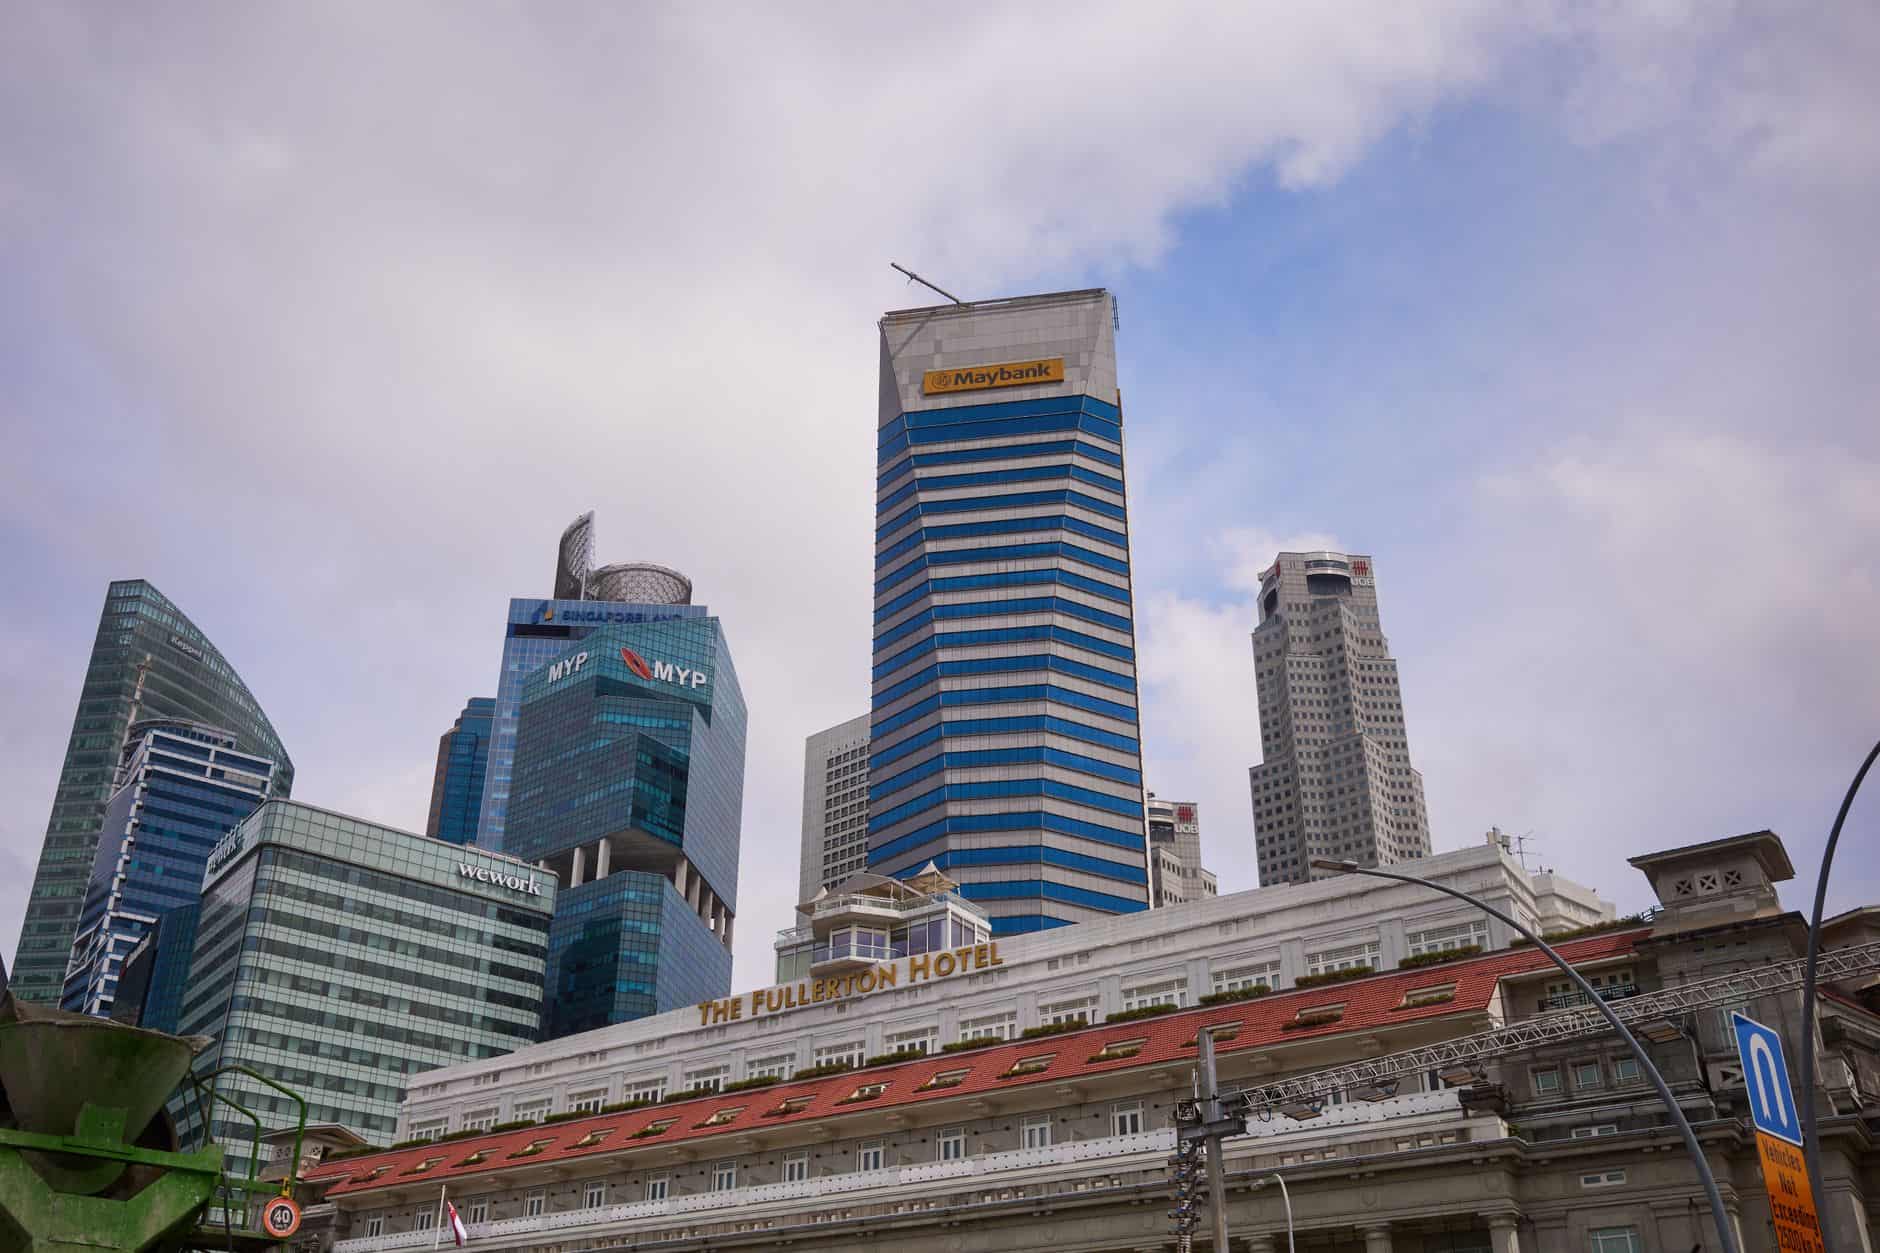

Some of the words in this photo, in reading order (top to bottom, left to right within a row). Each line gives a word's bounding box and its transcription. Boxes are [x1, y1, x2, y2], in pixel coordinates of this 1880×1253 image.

[953, 363, 1050, 385] Maybank
[1350, 577, 1375, 586] UOB
[548, 651, 588, 683] MYP
[653, 660, 706, 689] MYP
[1174, 823, 1199, 833] UOB
[458, 862, 542, 896] wework
[697, 997, 742, 1026] THE
[751, 963, 897, 1016] FULLERTON
[909, 943, 1003, 983] HOTEL
[1761, 1137, 1802, 1173] Vehicles
[1778, 1171, 1798, 1198] Not
[273, 1209, 291, 1223] 40
